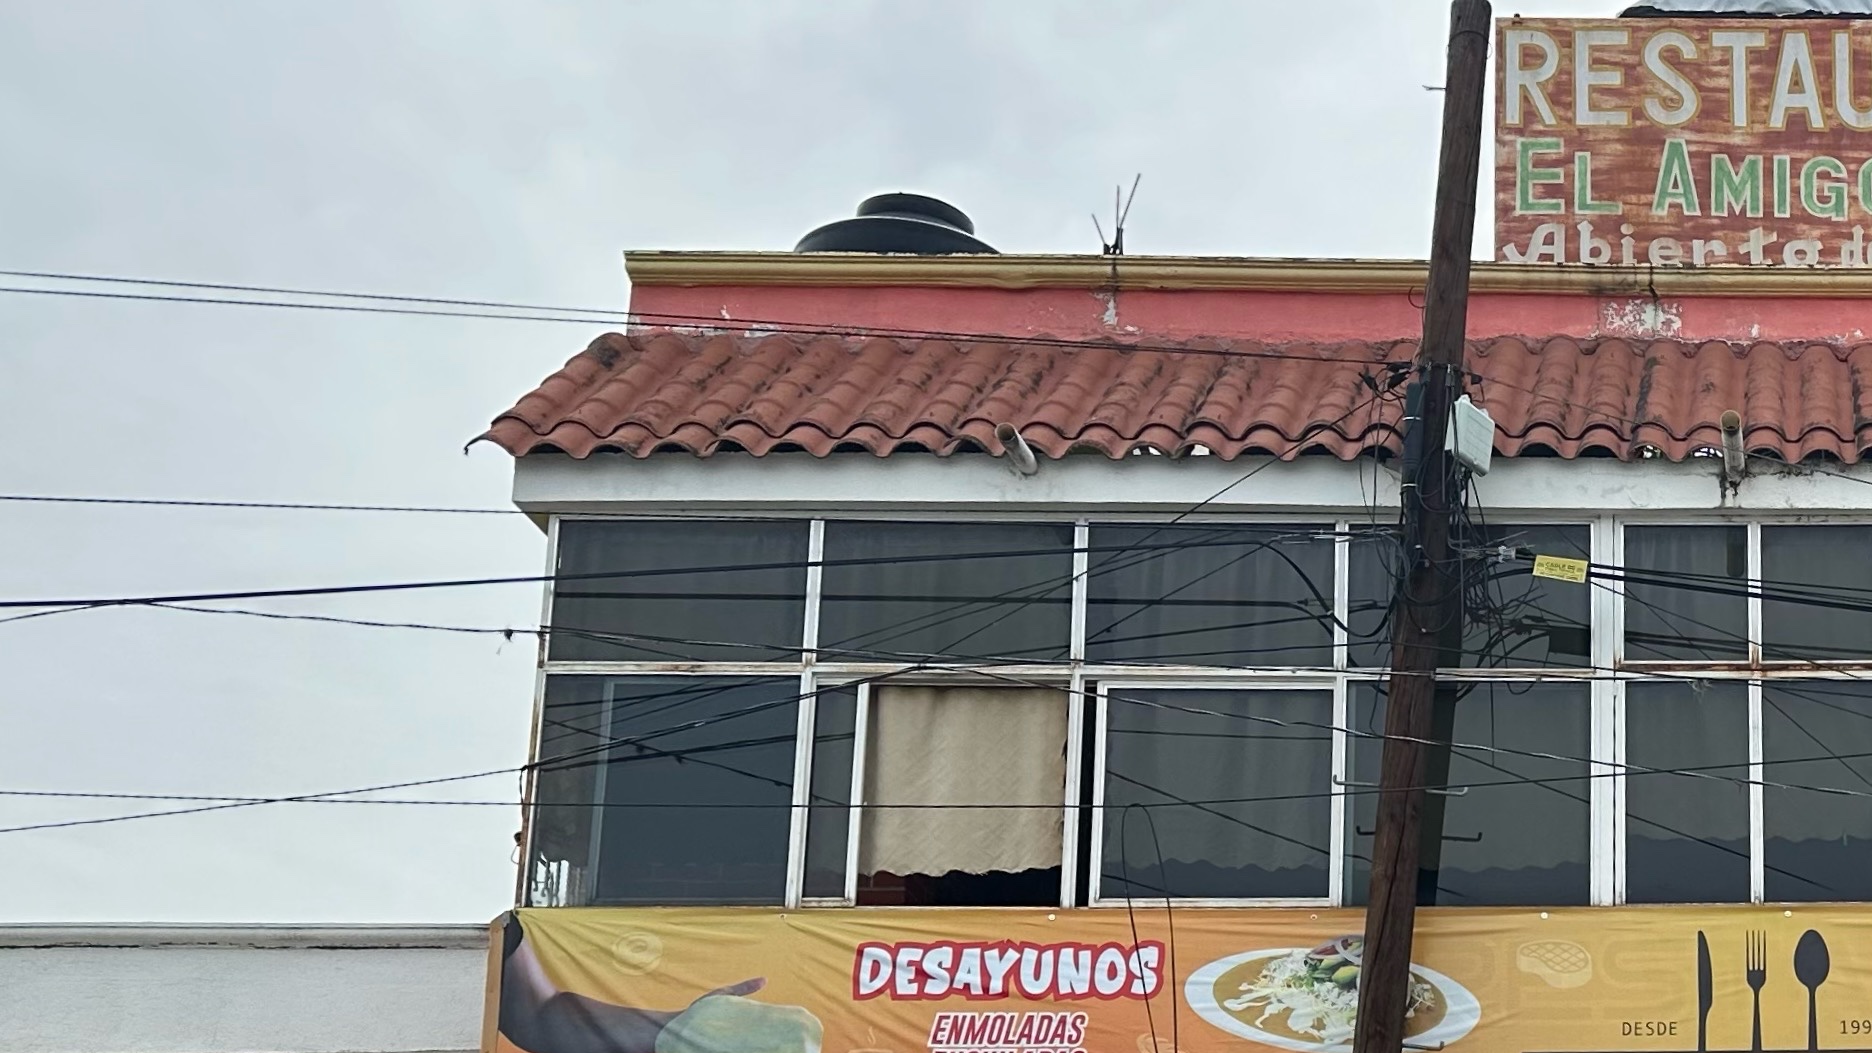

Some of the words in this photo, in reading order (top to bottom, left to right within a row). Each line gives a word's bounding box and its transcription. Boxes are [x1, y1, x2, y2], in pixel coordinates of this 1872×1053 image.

[1516, 138, 1621, 216] EL
[859, 945, 1159, 996] DESAYUNOS
[929, 1014, 1088, 1046] ENMOLADAS
[1621, 1021, 1678, 1037] DESDE
